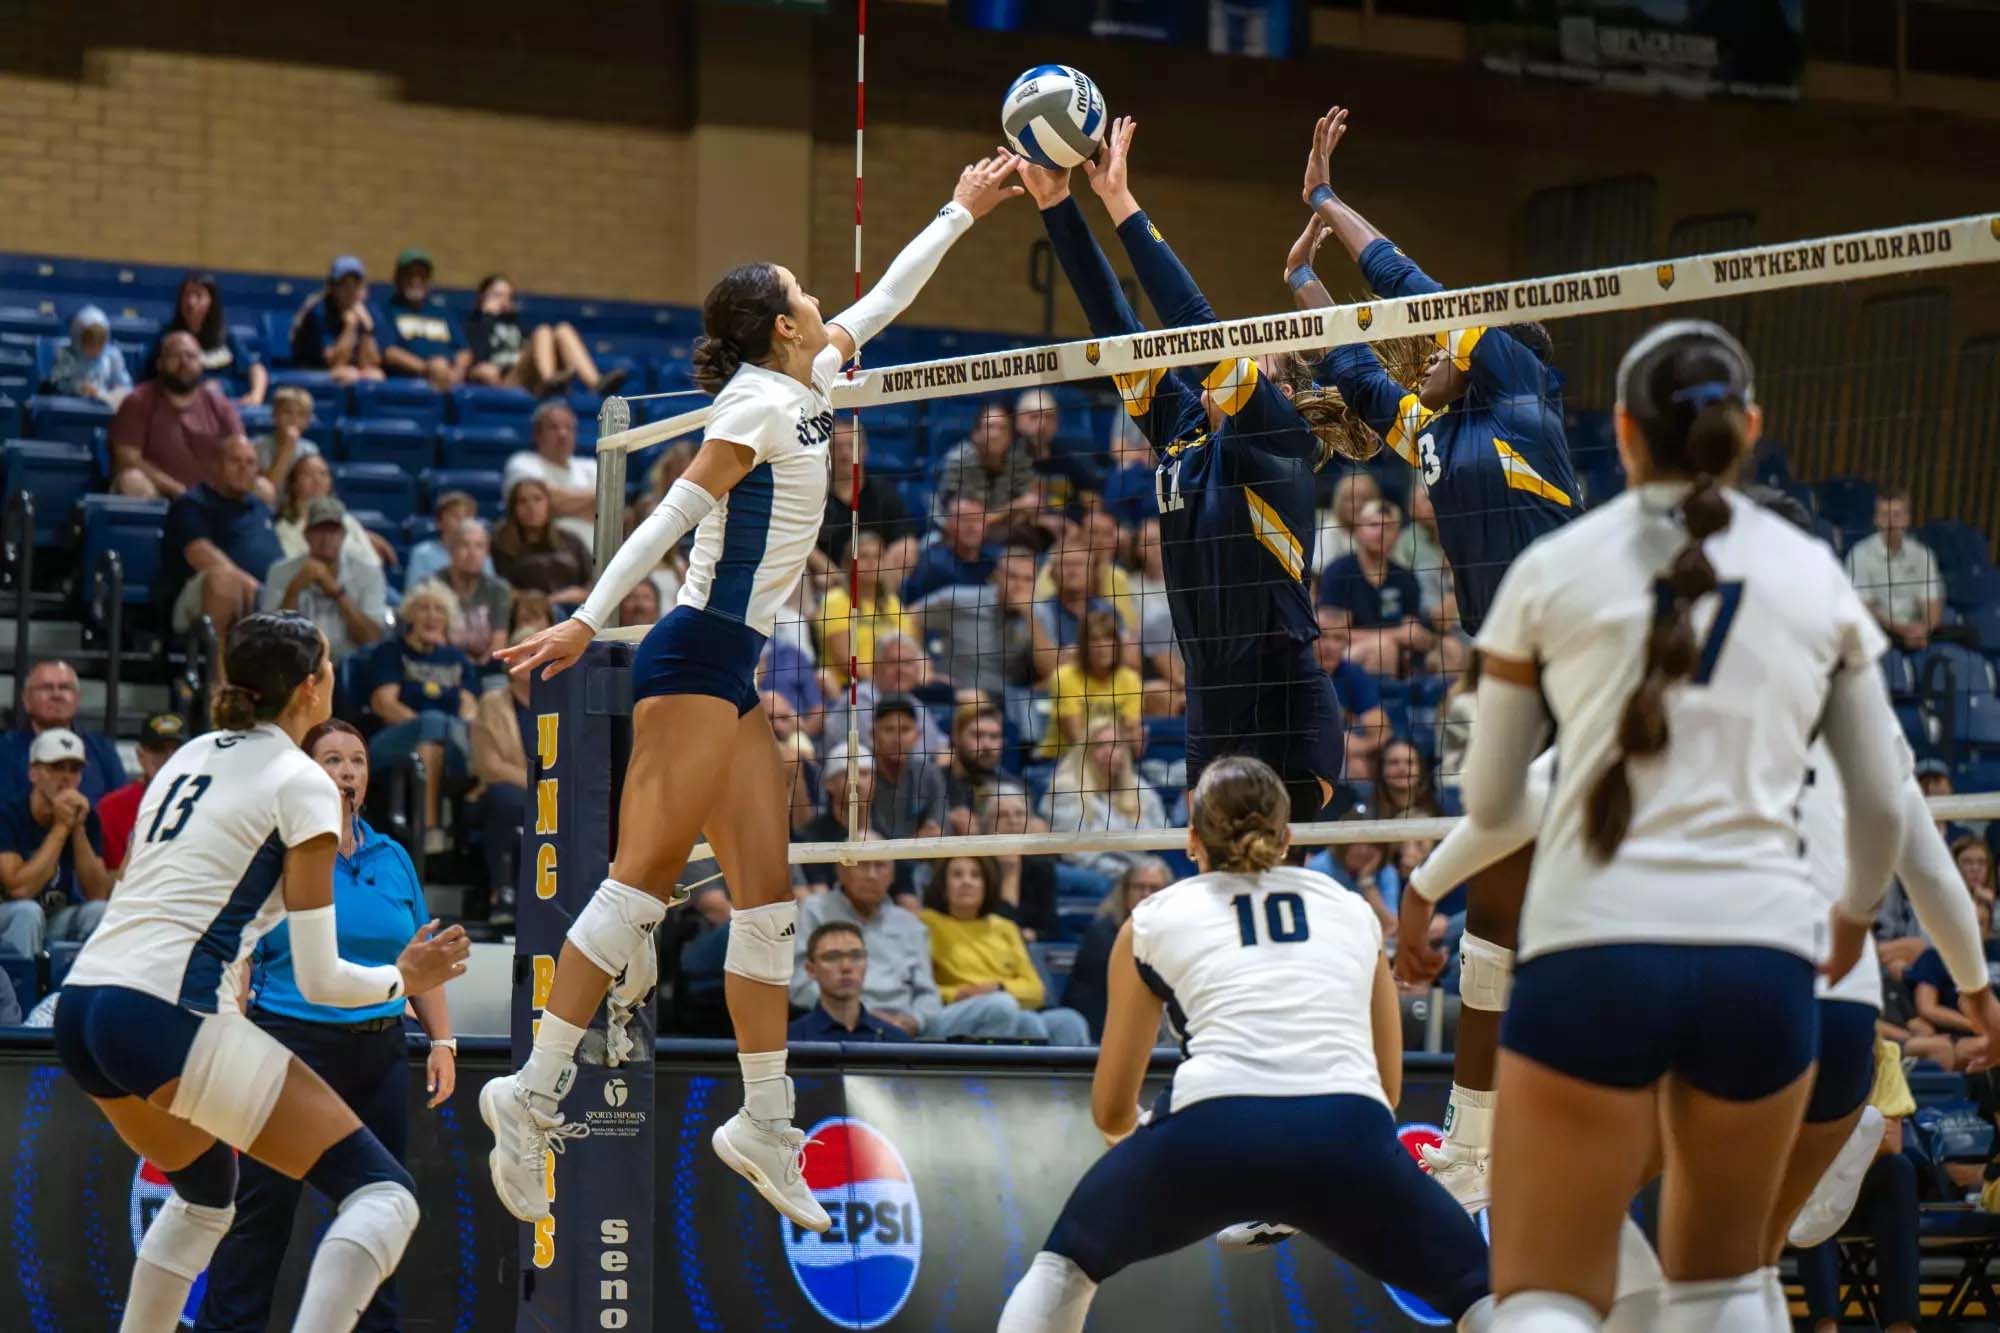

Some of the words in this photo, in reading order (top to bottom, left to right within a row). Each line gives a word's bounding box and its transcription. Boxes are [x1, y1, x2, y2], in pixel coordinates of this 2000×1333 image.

[1712, 244, 1827, 283] NORTHERN
[1833, 228, 1952, 266] COLORADO
[1406, 288, 1510, 323] NORTHERN
[1515, 274, 1621, 309] COLORADO
[1132, 327, 1225, 360] NORTHERN
[1228, 315, 1324, 346] COLORADO
[882, 362, 968, 393] NORTHERN
[971, 351, 1058, 382] COLORADO
[1418, 432, 1442, 487] 3
[145, 773, 213, 843] 13
[536, 712, 559, 900] UNC
[1230, 891, 1310, 948] 10
[585, 1111, 613, 1121] SPORTS
[613, 1111, 646, 1122] IMPORTS
[600, 1218, 630, 1329] seno
